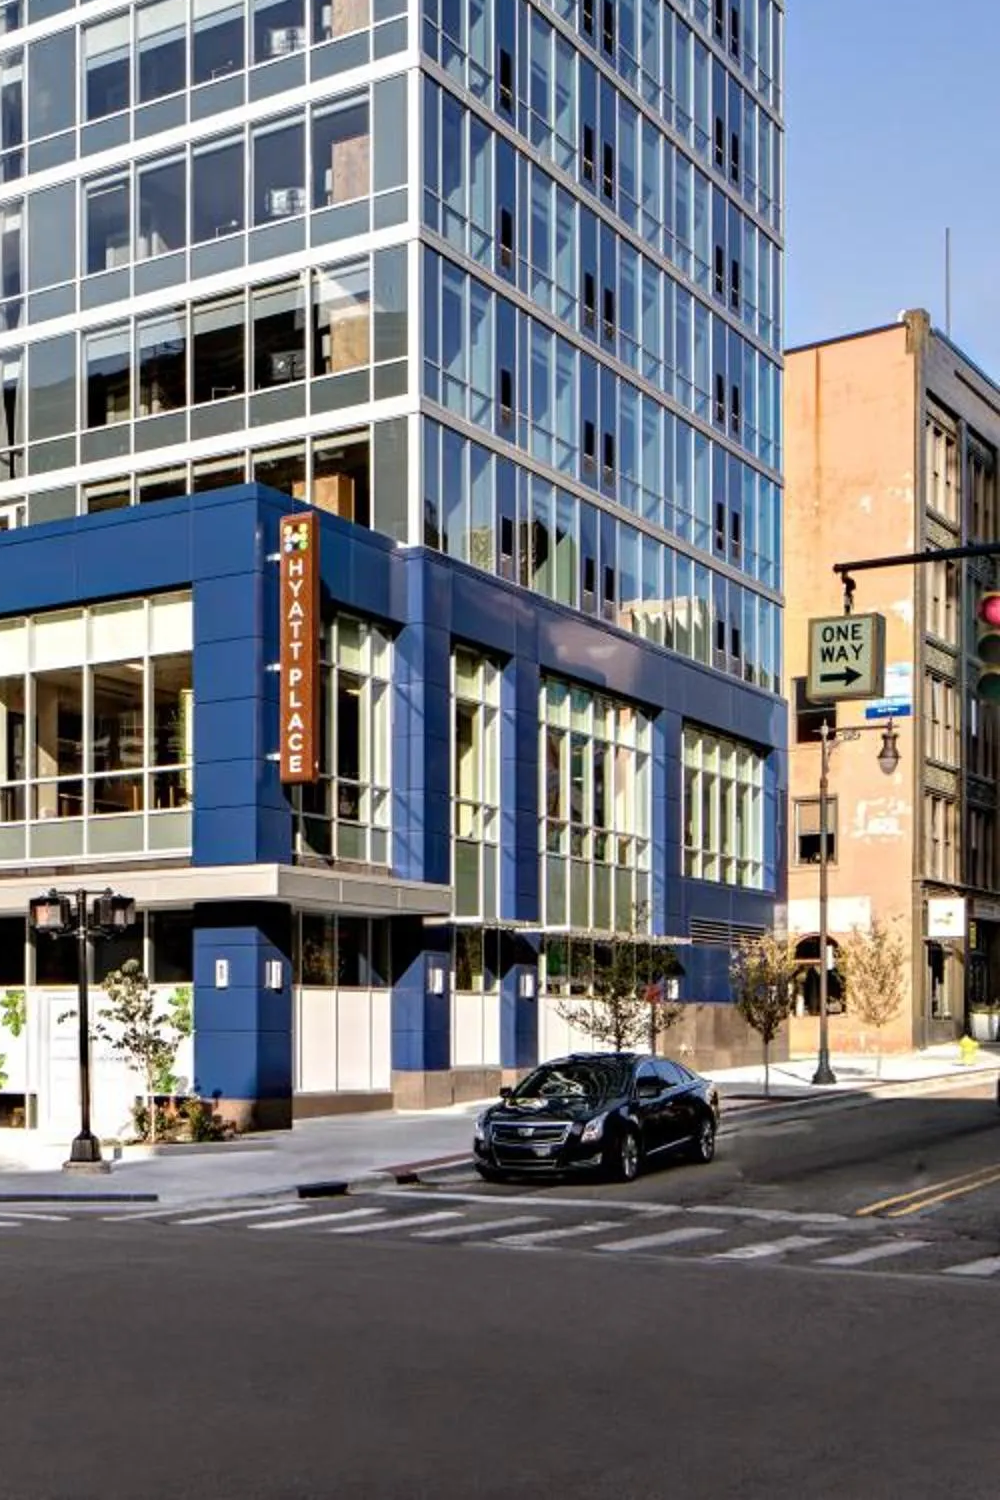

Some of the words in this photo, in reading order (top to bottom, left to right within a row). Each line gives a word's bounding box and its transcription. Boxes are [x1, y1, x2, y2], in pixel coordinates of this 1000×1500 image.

[287, 559, 303, 660] HYATT
[822, 623, 863, 643] ONE
[821, 643, 864, 663] WAY
[287, 668, 303, 773] PLACE
